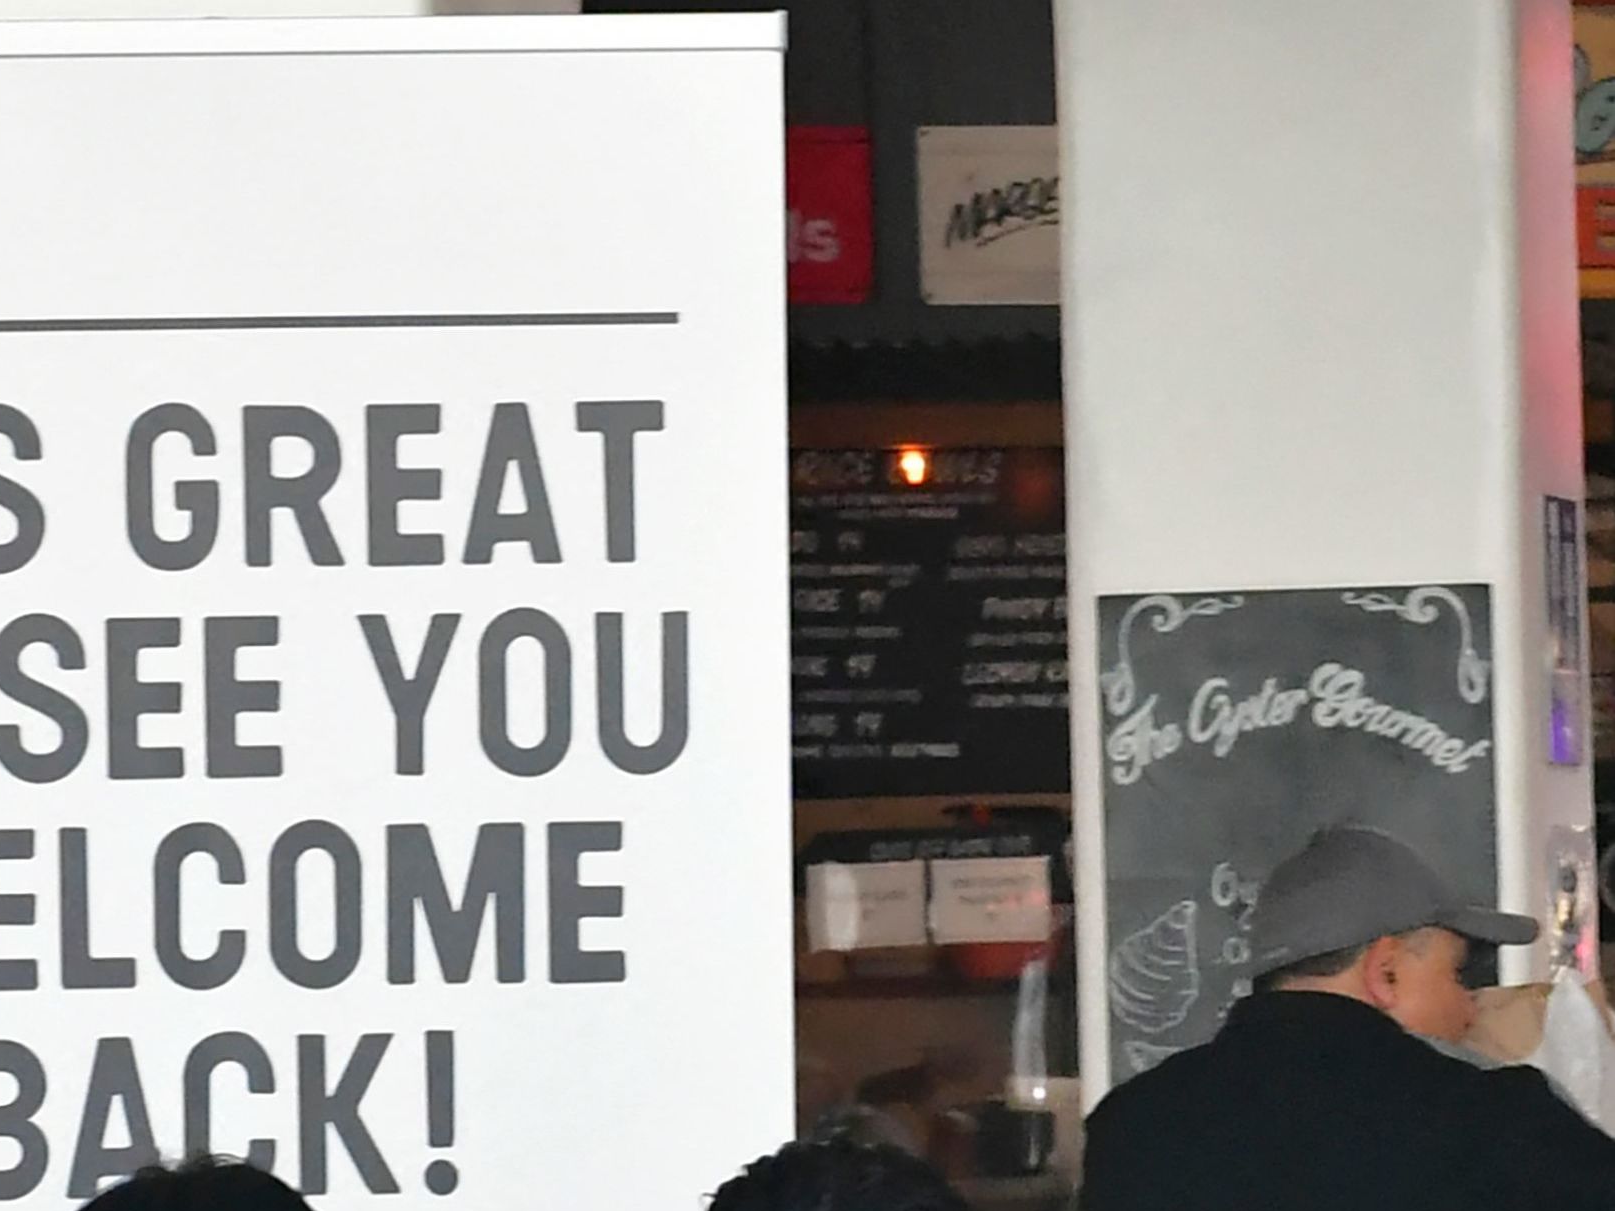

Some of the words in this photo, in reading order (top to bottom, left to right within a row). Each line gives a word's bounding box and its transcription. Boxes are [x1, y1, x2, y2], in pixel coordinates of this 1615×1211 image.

[125, 399, 665, 573] GREAT
[356, 606, 690, 779] YOU
[1188, 676, 1310, 758] Oyster
[1308, 661, 1491, 774] Gourmet
